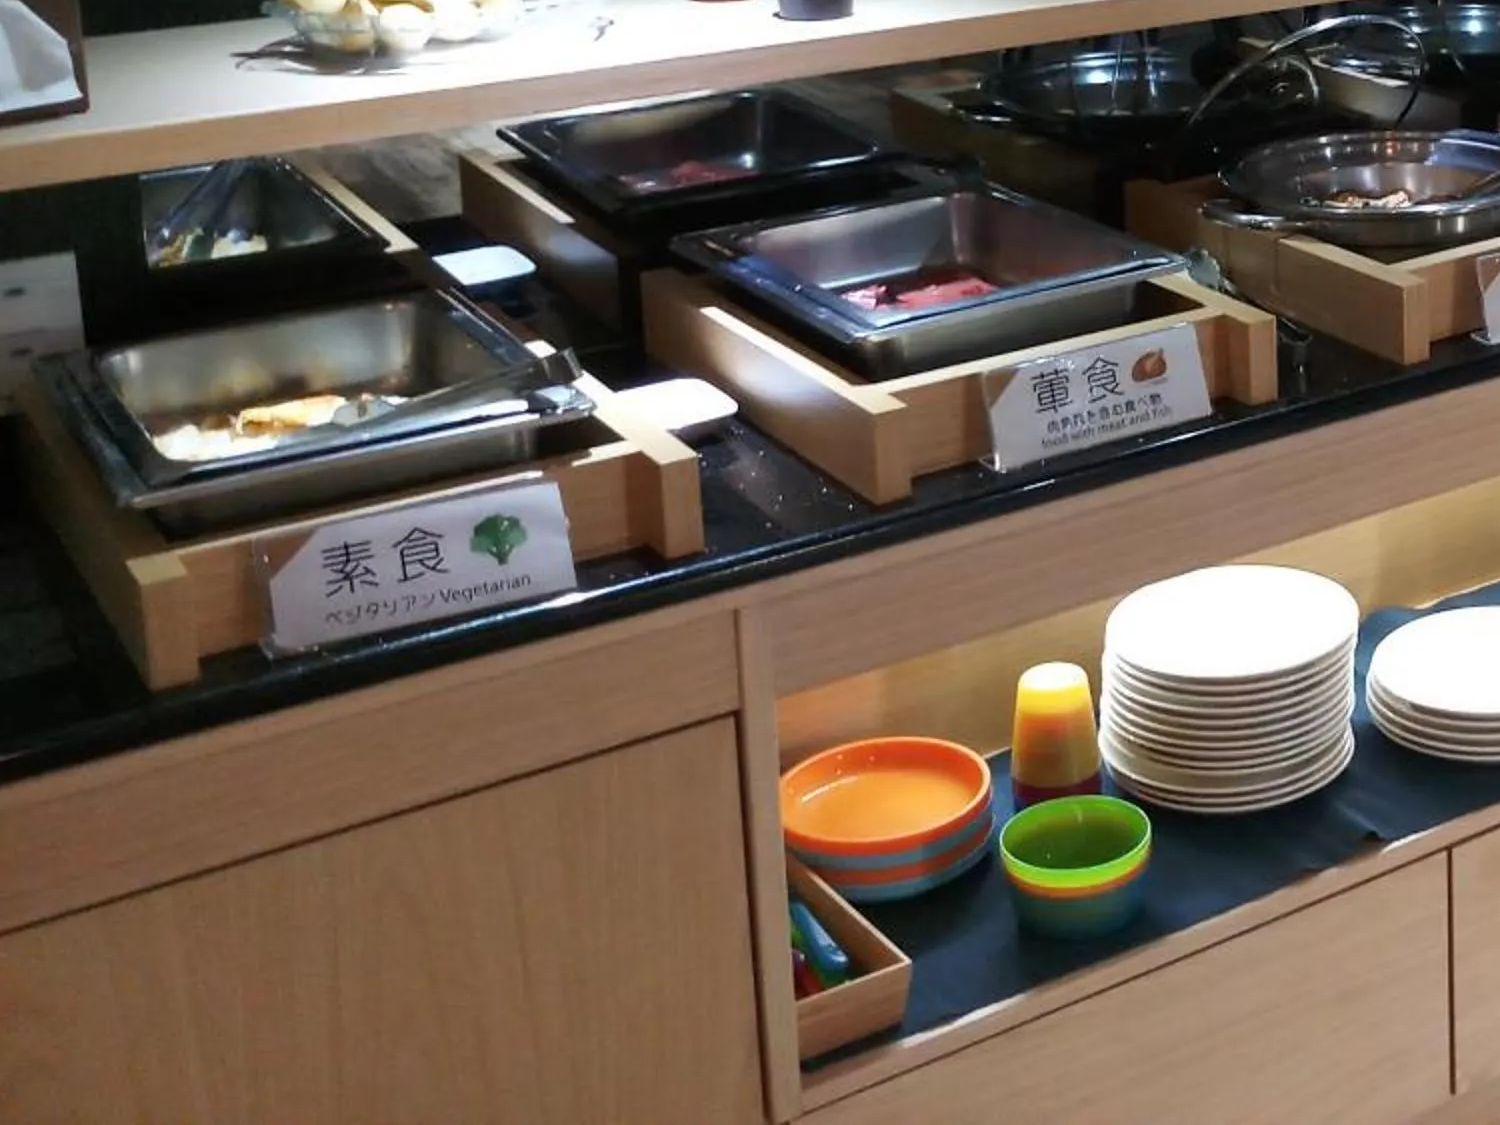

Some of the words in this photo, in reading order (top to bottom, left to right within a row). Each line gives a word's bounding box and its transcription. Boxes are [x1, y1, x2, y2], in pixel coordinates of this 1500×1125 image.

[1031, 356, 1124, 414] 葷食
[320, 527, 450, 598] 素食
[439, 574, 532, 604] Vegetarian
